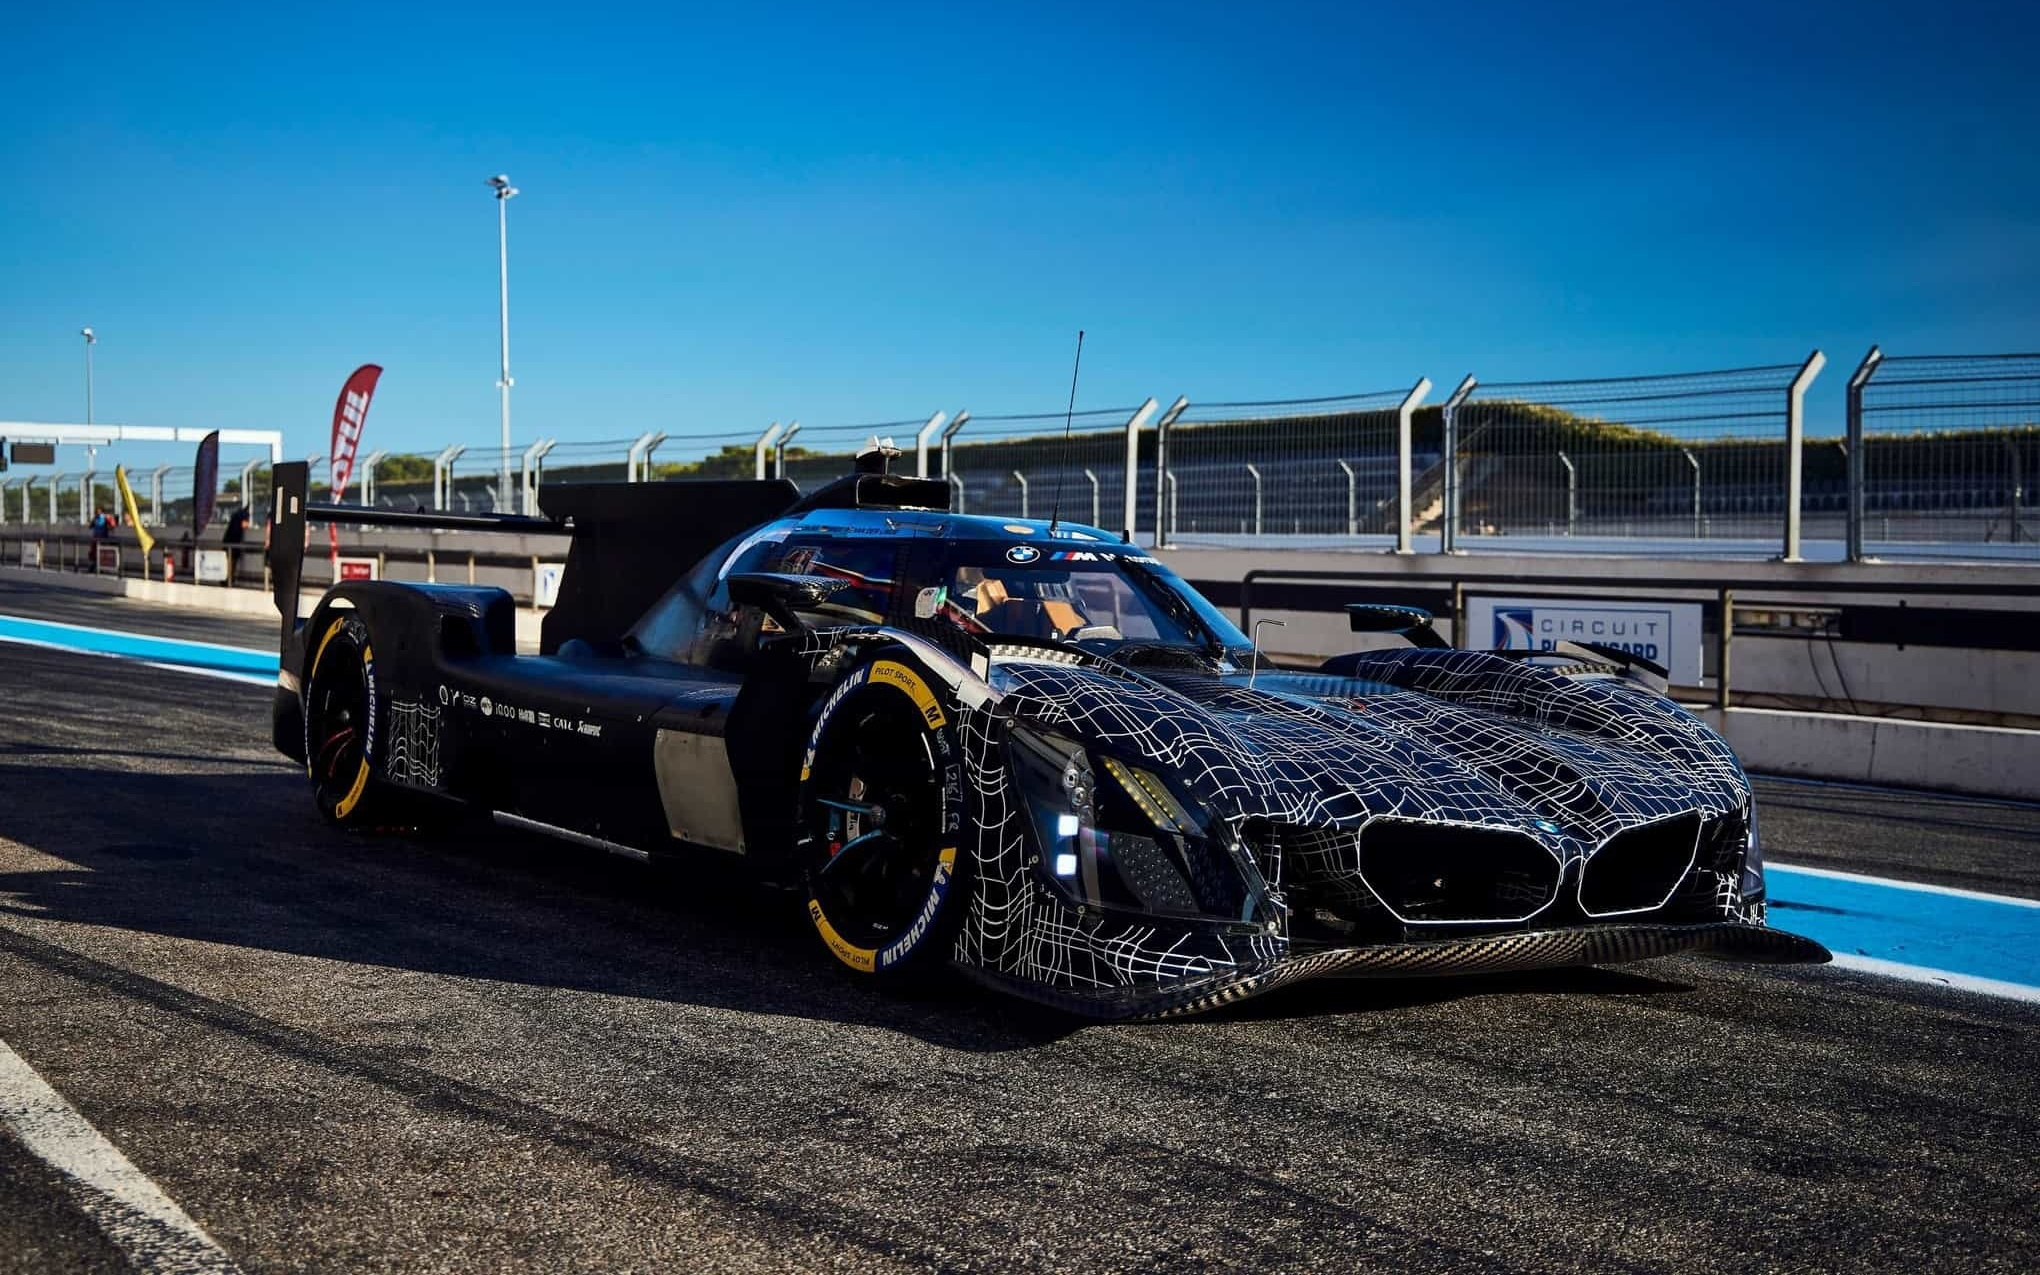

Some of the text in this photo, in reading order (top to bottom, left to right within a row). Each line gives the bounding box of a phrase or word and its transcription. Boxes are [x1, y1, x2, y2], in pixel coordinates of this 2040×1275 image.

[330, 390, 369, 505] OTUL
[1541, 619, 1658, 637] CIRCUIT
[366, 674, 376, 755] MICHELIN
[812, 667, 865, 745] MICHELIN
[875, 667, 917, 689] PILOT SPORT
[925, 705, 941, 723] M
[882, 887, 940, 966] MICHELIN
